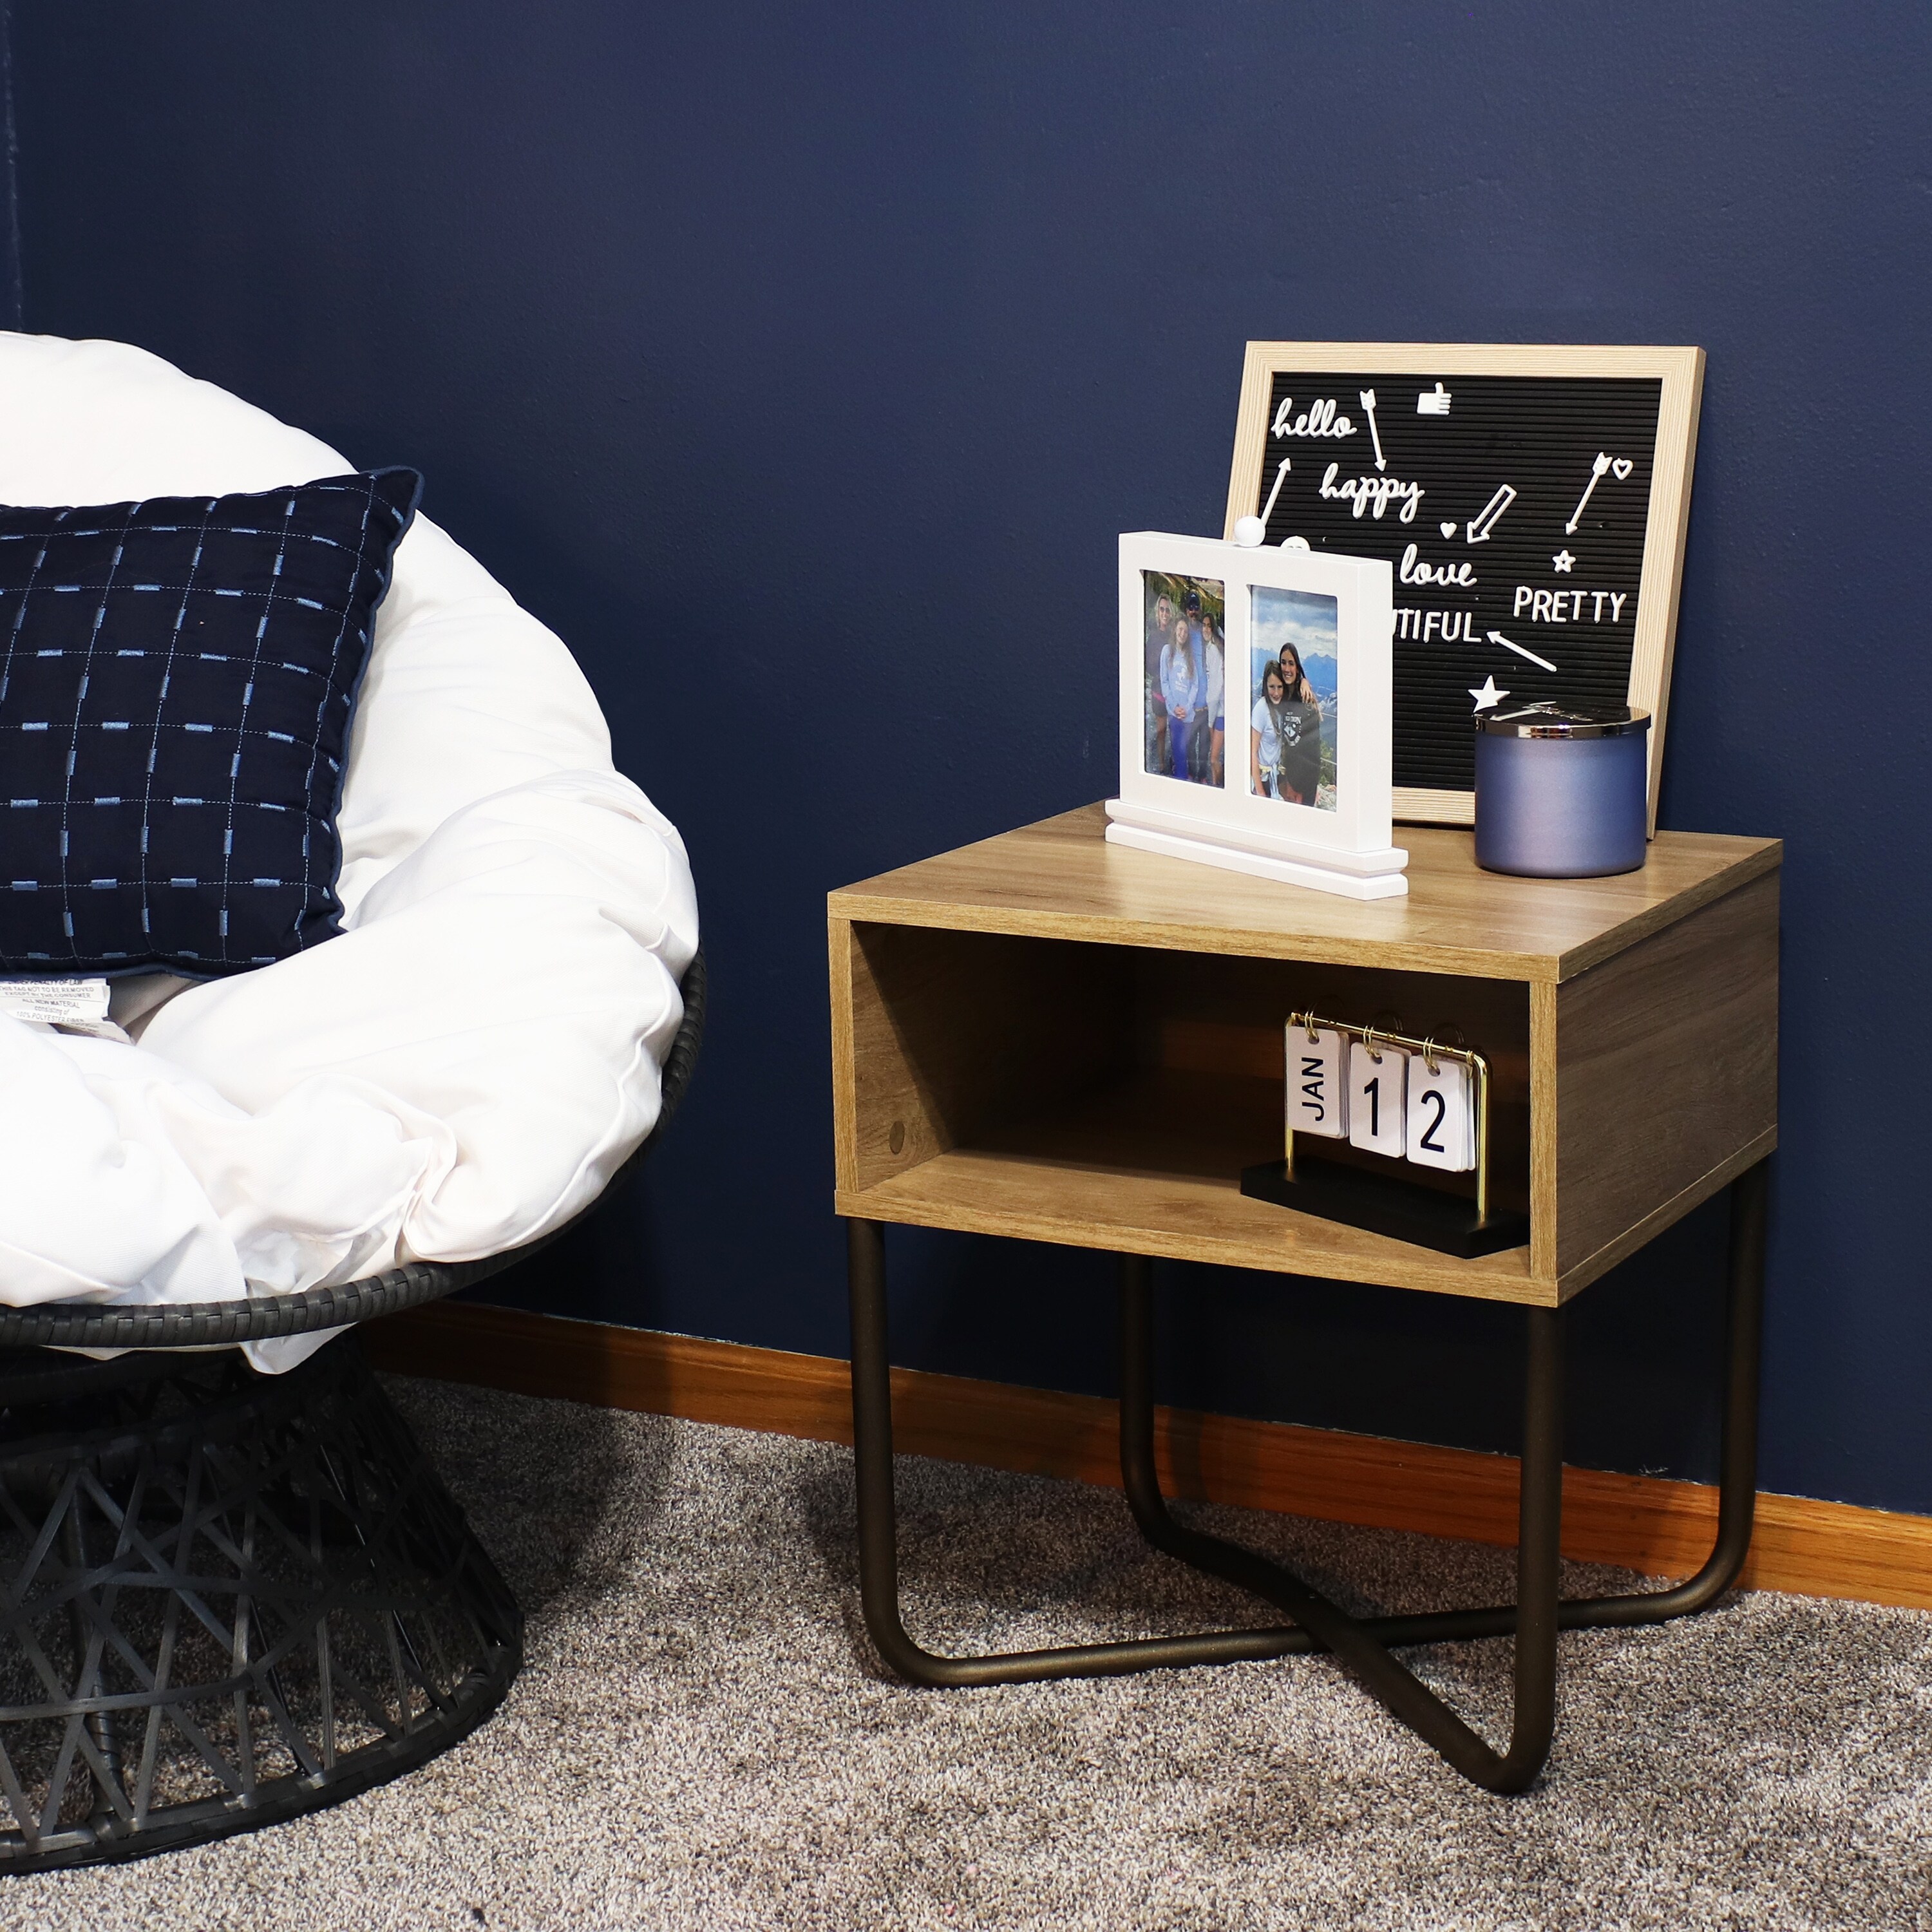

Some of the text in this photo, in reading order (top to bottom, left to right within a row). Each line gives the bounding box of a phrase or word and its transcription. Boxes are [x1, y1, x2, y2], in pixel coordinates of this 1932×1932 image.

[1271, 397, 1357, 439] hello
[1318, 462, 1426, 525] happy
[1399, 543, 1478, 587] love
[1513, 585, 1627, 623] PRETTY
[32, 1012, 65, 1023] POLYESTER
[34, 1005, 62, 1016] consisting
[1302, 1057, 1446, 1153] JAN 1 2
